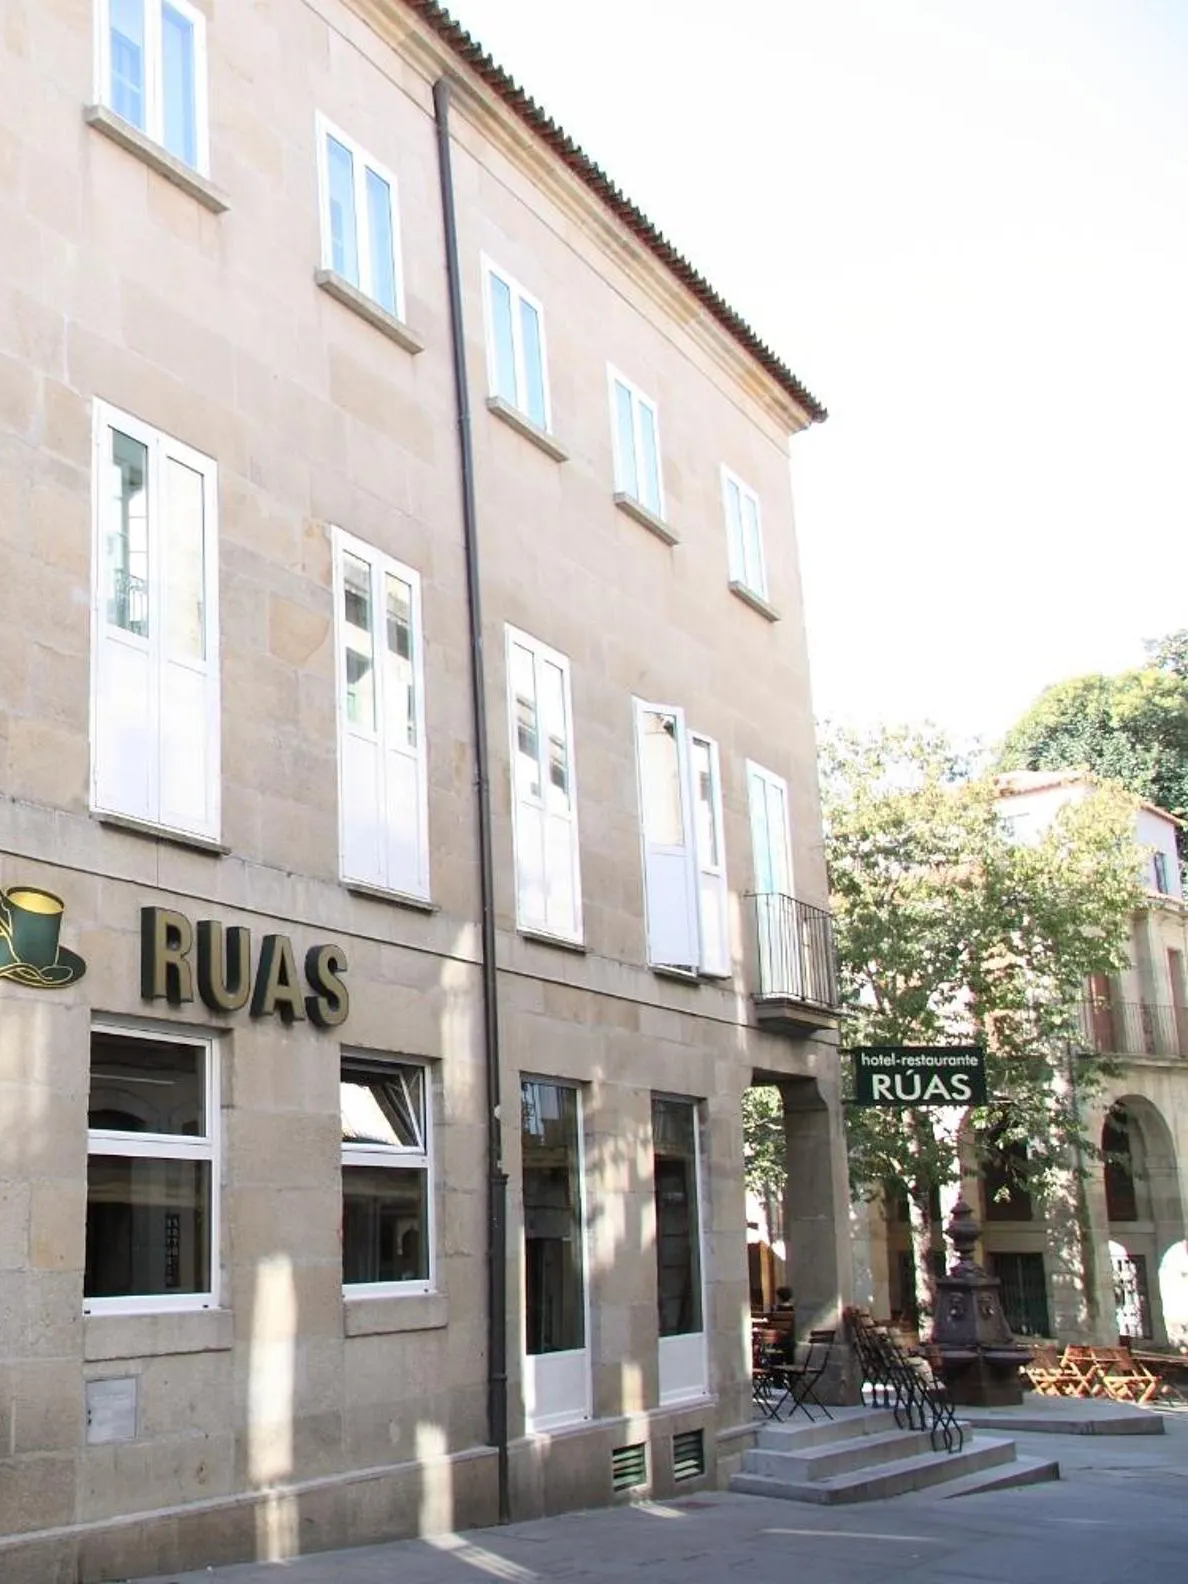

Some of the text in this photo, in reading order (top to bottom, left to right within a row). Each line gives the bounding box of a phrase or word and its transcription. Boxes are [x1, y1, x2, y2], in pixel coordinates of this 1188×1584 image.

[140, 906, 349, 1028] RUAS
[861, 1052, 979, 1067] hotel-restaurante
[872, 1069, 972, 1101] RÚAS
